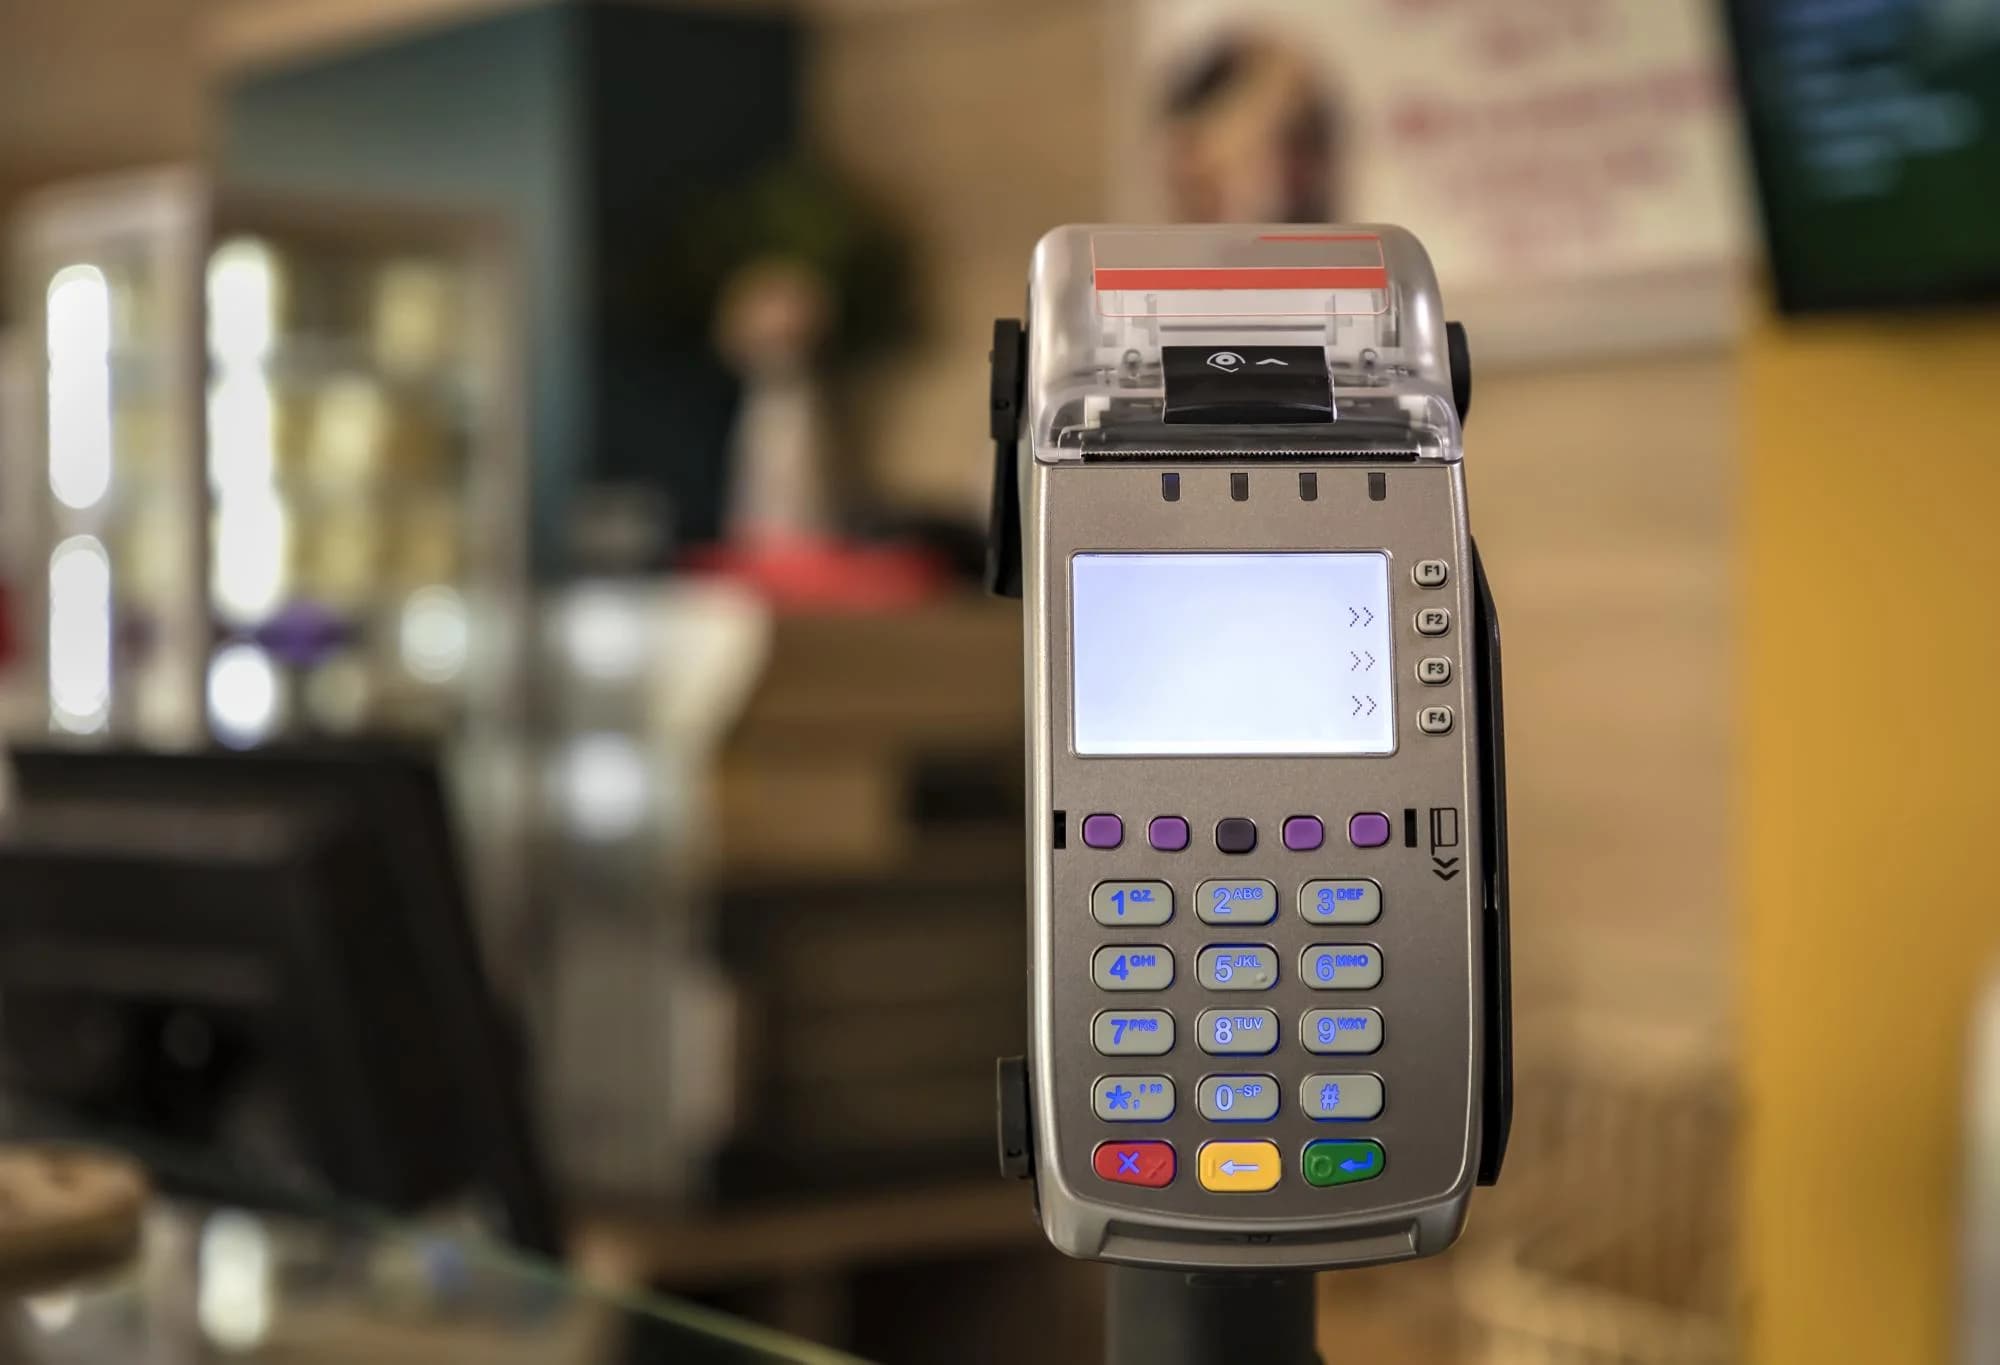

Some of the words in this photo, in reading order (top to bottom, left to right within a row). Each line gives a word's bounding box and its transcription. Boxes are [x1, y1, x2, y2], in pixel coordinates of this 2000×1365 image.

[1424, 565, 1440, 576] F1
[1426, 614, 1443, 624] F2
[1428, 663, 1444, 674] F3
[1429, 712, 1446, 723] F4
[1111, 890, 1126, 917] 1
[1212, 886, 1232, 915] 2
[1233, 887, 1264, 901] ABC
[1317, 888, 1335, 916] 3
[1336, 888, 1364, 901] DEF
[1109, 955, 1129, 981] 4
[1129, 954, 1157, 968] GHI
[1215, 954, 1233, 983] 5
[1234, 954, 1261, 968] JKL
[1315, 954, 1334, 982] 6
[1335, 954, 1369, 968] MNO
[1110, 1018, 1128, 1045] 7
[1129, 1018, 1159, 1032] PRS
[1214, 1016, 1233, 1044] 8
[1234, 1016, 1263, 1029] TUV
[1317, 1017, 1336, 1044] 9
[1337, 1017, 1368, 1030] WXY
[1215, 1084, 1235, 1112] 0
[1320, 1083, 1340, 1110] #
